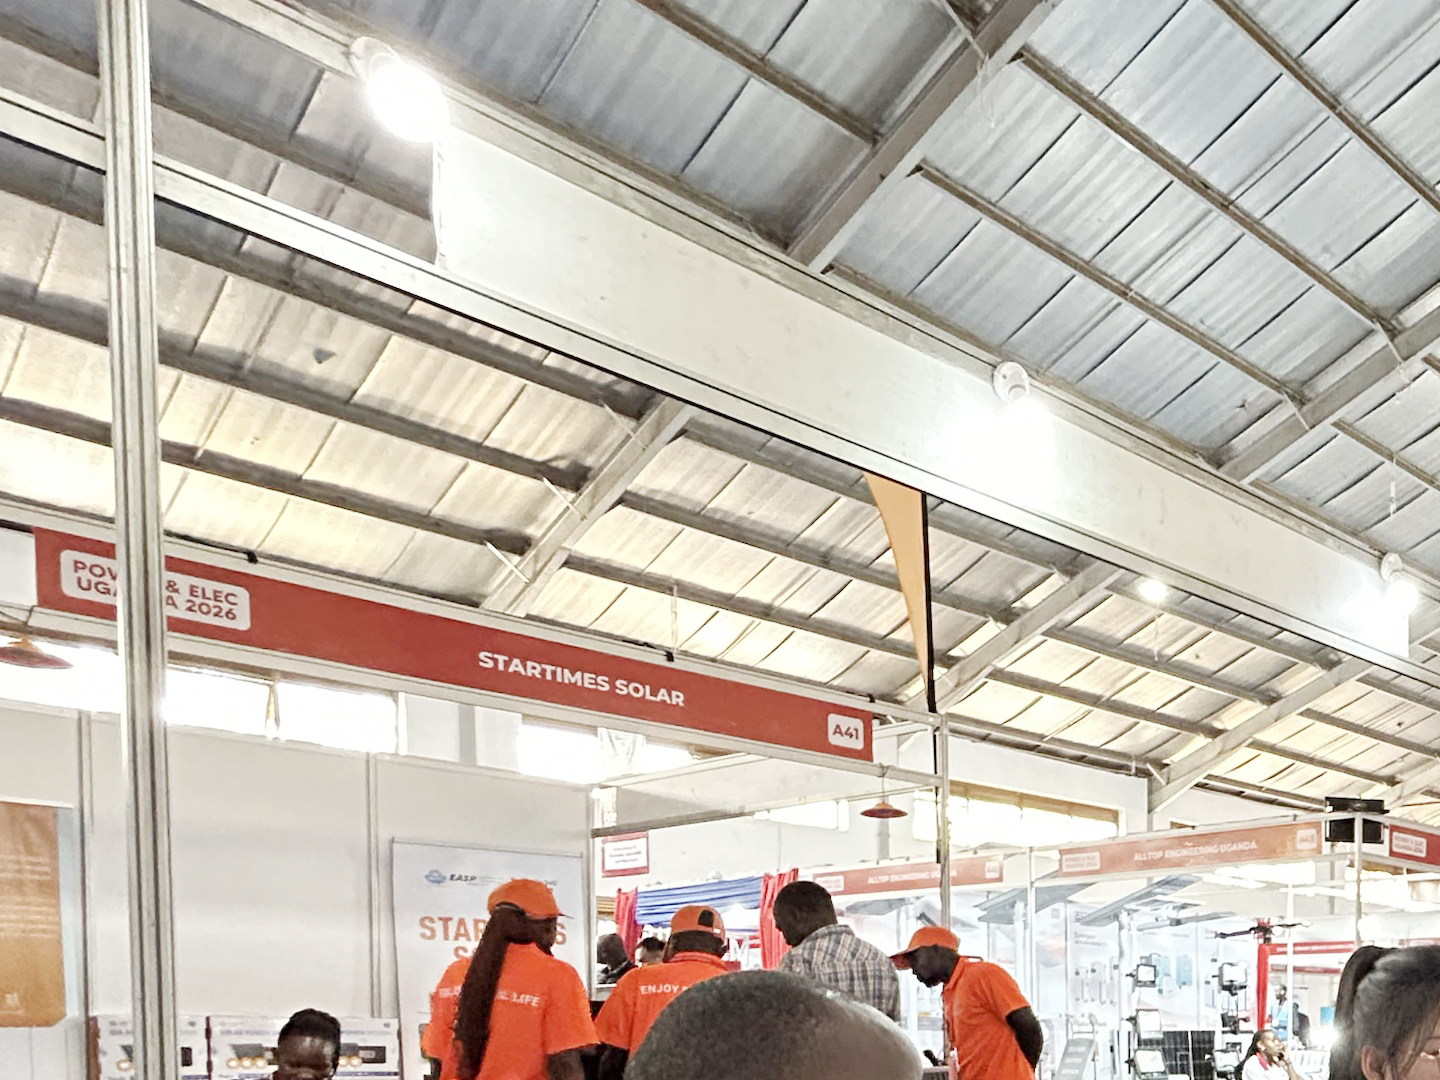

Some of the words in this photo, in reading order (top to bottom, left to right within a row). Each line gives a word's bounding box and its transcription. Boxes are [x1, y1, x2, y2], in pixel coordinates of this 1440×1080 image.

[189, 584, 238, 606] ELEC
[185, 600, 237, 621] 2026
[478, 651, 610, 693] STARTIMES
[615, 678, 685, 708] SOLAR
[832, 723, 859, 741] A41
[1220, 840, 1257, 854] UGANDA
[640, 983, 679, 995] ENJOY
[512, 991, 541, 1007] LIFE
